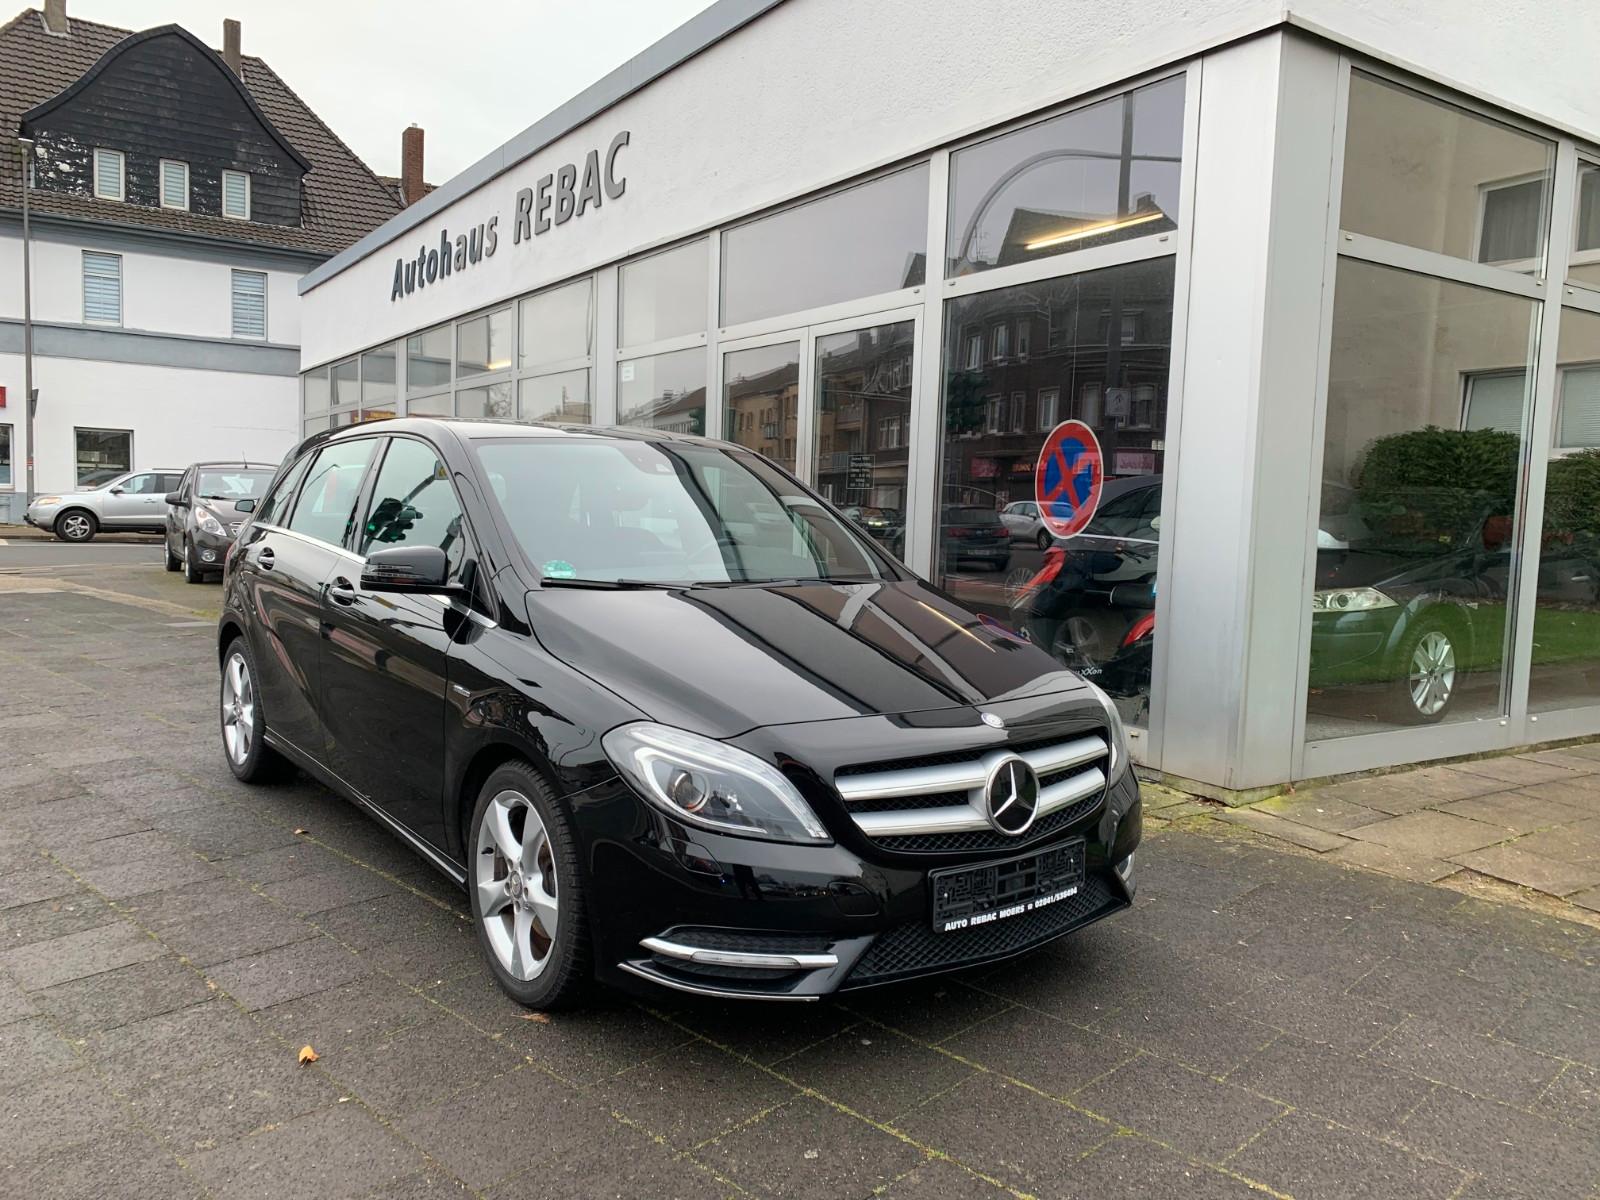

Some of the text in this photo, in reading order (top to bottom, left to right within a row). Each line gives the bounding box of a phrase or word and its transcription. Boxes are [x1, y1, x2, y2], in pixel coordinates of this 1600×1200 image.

[391, 130, 630, 301] Autohaus REBAC
[945, 919, 968, 931] AUTO
[970, 912, 997, 926] REBAC
[999, 904, 1025, 919] MOERS
